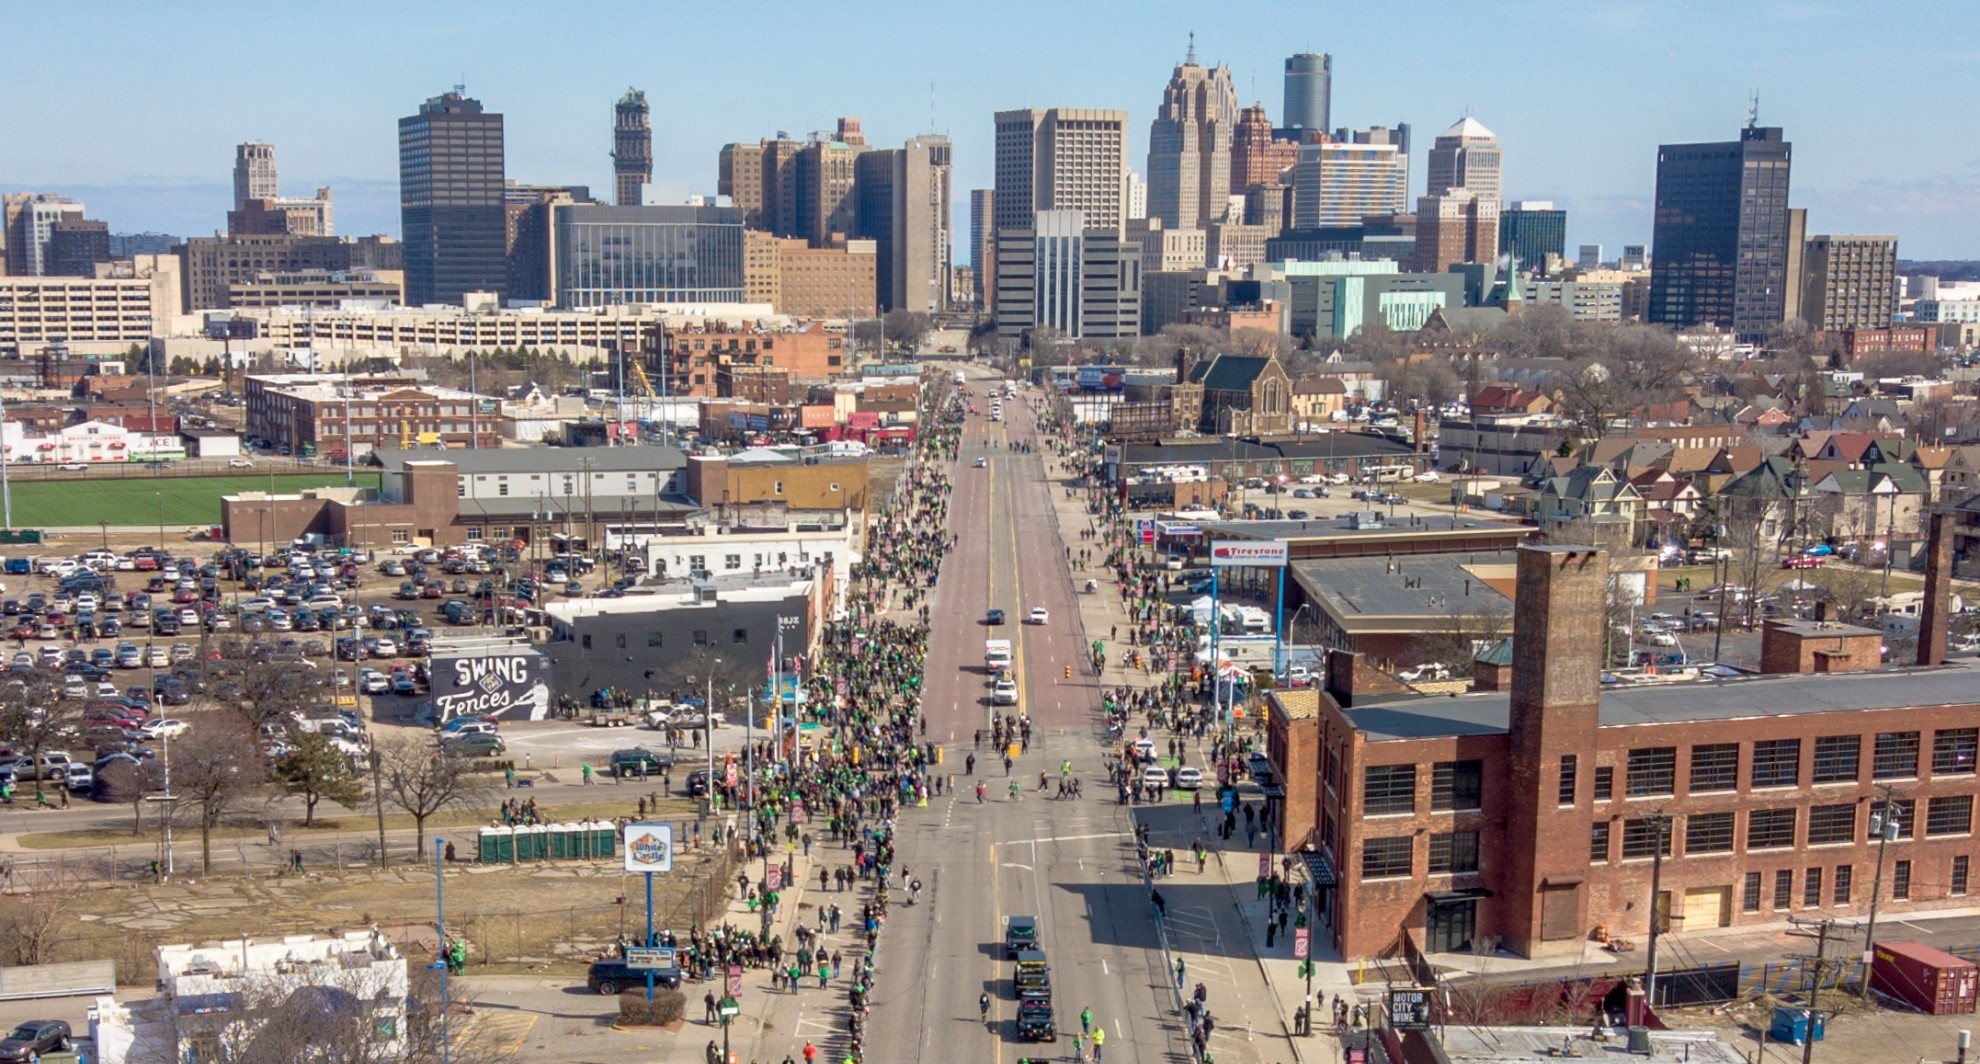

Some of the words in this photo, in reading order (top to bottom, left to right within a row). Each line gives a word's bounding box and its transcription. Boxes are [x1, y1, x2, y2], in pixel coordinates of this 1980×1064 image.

[1231, 547, 1284, 555] Firestone
[455, 657, 527, 686] SWING
[436, 690, 511, 723] Fences
[636, 843, 663, 853] White
[632, 851, 665, 861] Castle
[1393, 992, 1423, 1003] MOTOR
[1393, 1002, 1412, 1012] CITY
[1393, 1012, 1415, 1022] WINE
